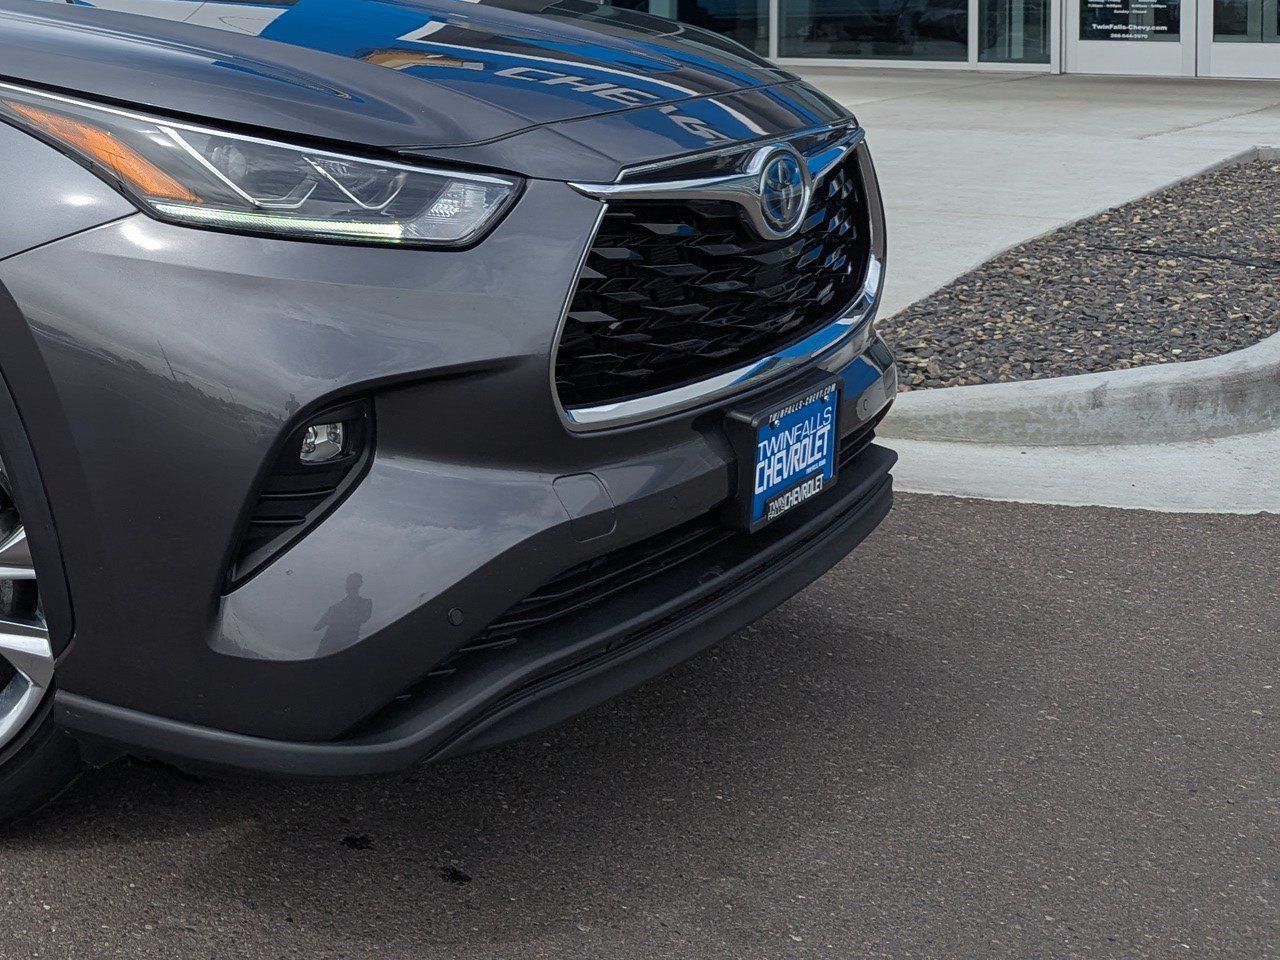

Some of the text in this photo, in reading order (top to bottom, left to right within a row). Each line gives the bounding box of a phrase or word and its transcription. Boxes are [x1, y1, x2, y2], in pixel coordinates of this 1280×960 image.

[1092, 24, 1168, 32] TwinFalls-Chevy.com
[758, 406, 832, 461] TWINFALLS
[754, 424, 831, 495] CHEVROLET
[783, 473, 824, 511] CHEVROLET
